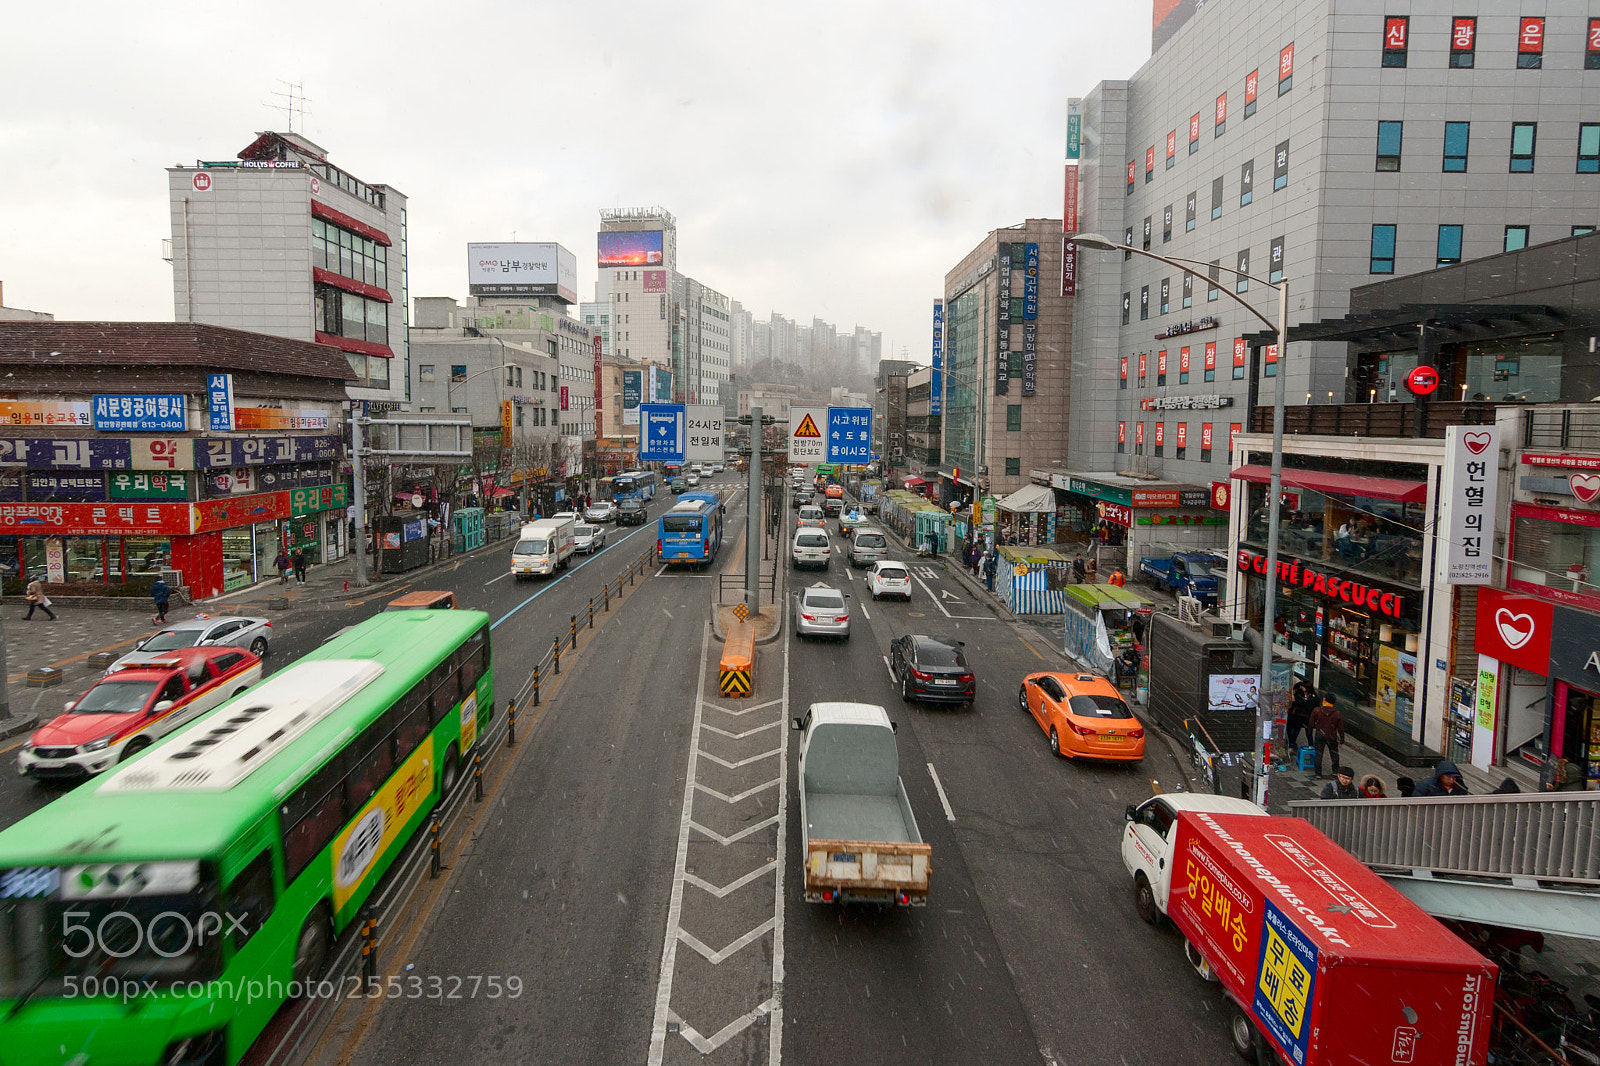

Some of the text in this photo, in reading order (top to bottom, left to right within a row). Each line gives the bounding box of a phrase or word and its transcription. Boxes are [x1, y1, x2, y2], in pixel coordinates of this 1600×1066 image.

[1066, 253, 1074, 281] 공단기
[999, 256, 1010, 321] 취업사관학교
[934, 310, 942, 359] 서울G고시
[210, 377, 226, 404] 서문
[97, 397, 182, 418] 서문항공여행사
[142, 421, 182, 429] 813-0400
[688, 420, 721, 431] 24시간
[149, 440, 177, 469] 약
[207, 438, 299, 467] 김안과
[690, 437, 719, 448] 전일제
[831, 446, 867, 456] 줄이시오
[102, 459, 125, 468] 의원
[31, 478, 58, 488] 김안과
[115, 474, 185, 492] 우리약국
[217, 475, 230, 489] 약
[293, 485, 346, 514] 우리약국
[688, 519, 699, 528] 751
[1303, 569, 1401, 618] PASCUCCI
[1192, 845, 1250, 908] www.homeplus.co.kr
[1196, 813, 1351, 948] www.homeplus.co.kr
[1186, 859, 1249, 953] 당일배송
[1269, 938, 1305, 997] 무료
[1264, 966, 1299, 1027] 배송
